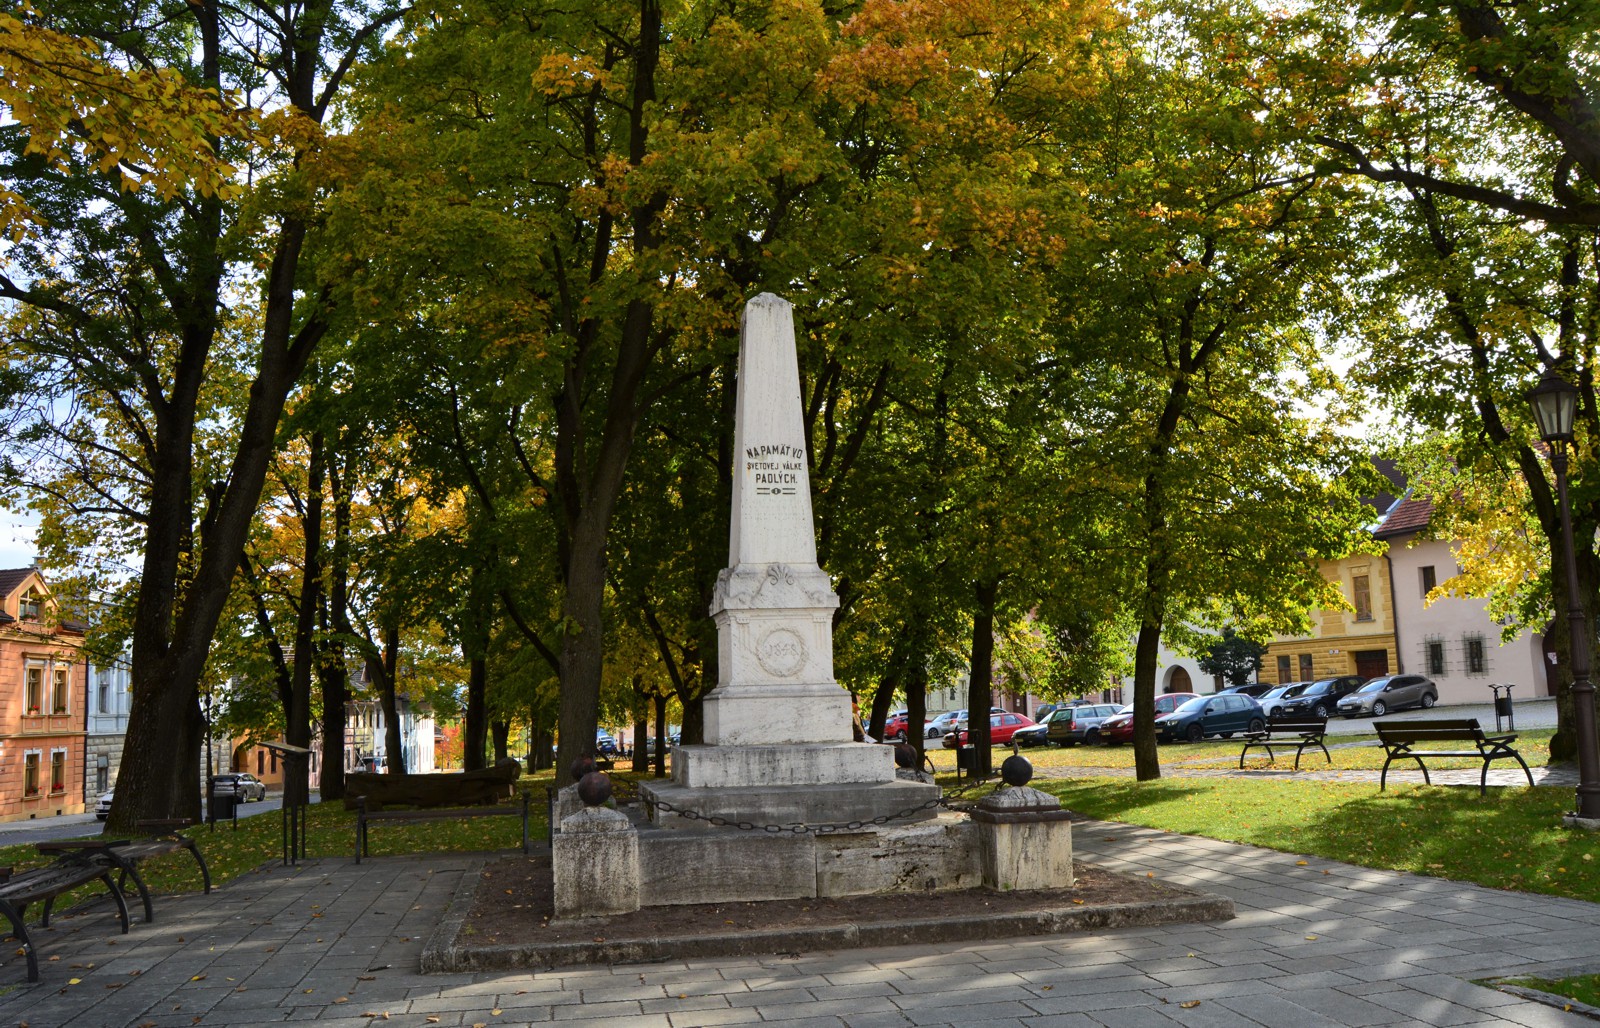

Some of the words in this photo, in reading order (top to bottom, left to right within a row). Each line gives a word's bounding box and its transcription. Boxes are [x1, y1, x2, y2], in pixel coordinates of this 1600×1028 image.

[746, 447, 760, 459] NA
[792, 447, 803, 459] VO
[747, 462, 779, 470] SVETOVEJ
[782, 460, 802, 470] VÁLKE
[756, 471, 798, 484] PADLÝCH.
